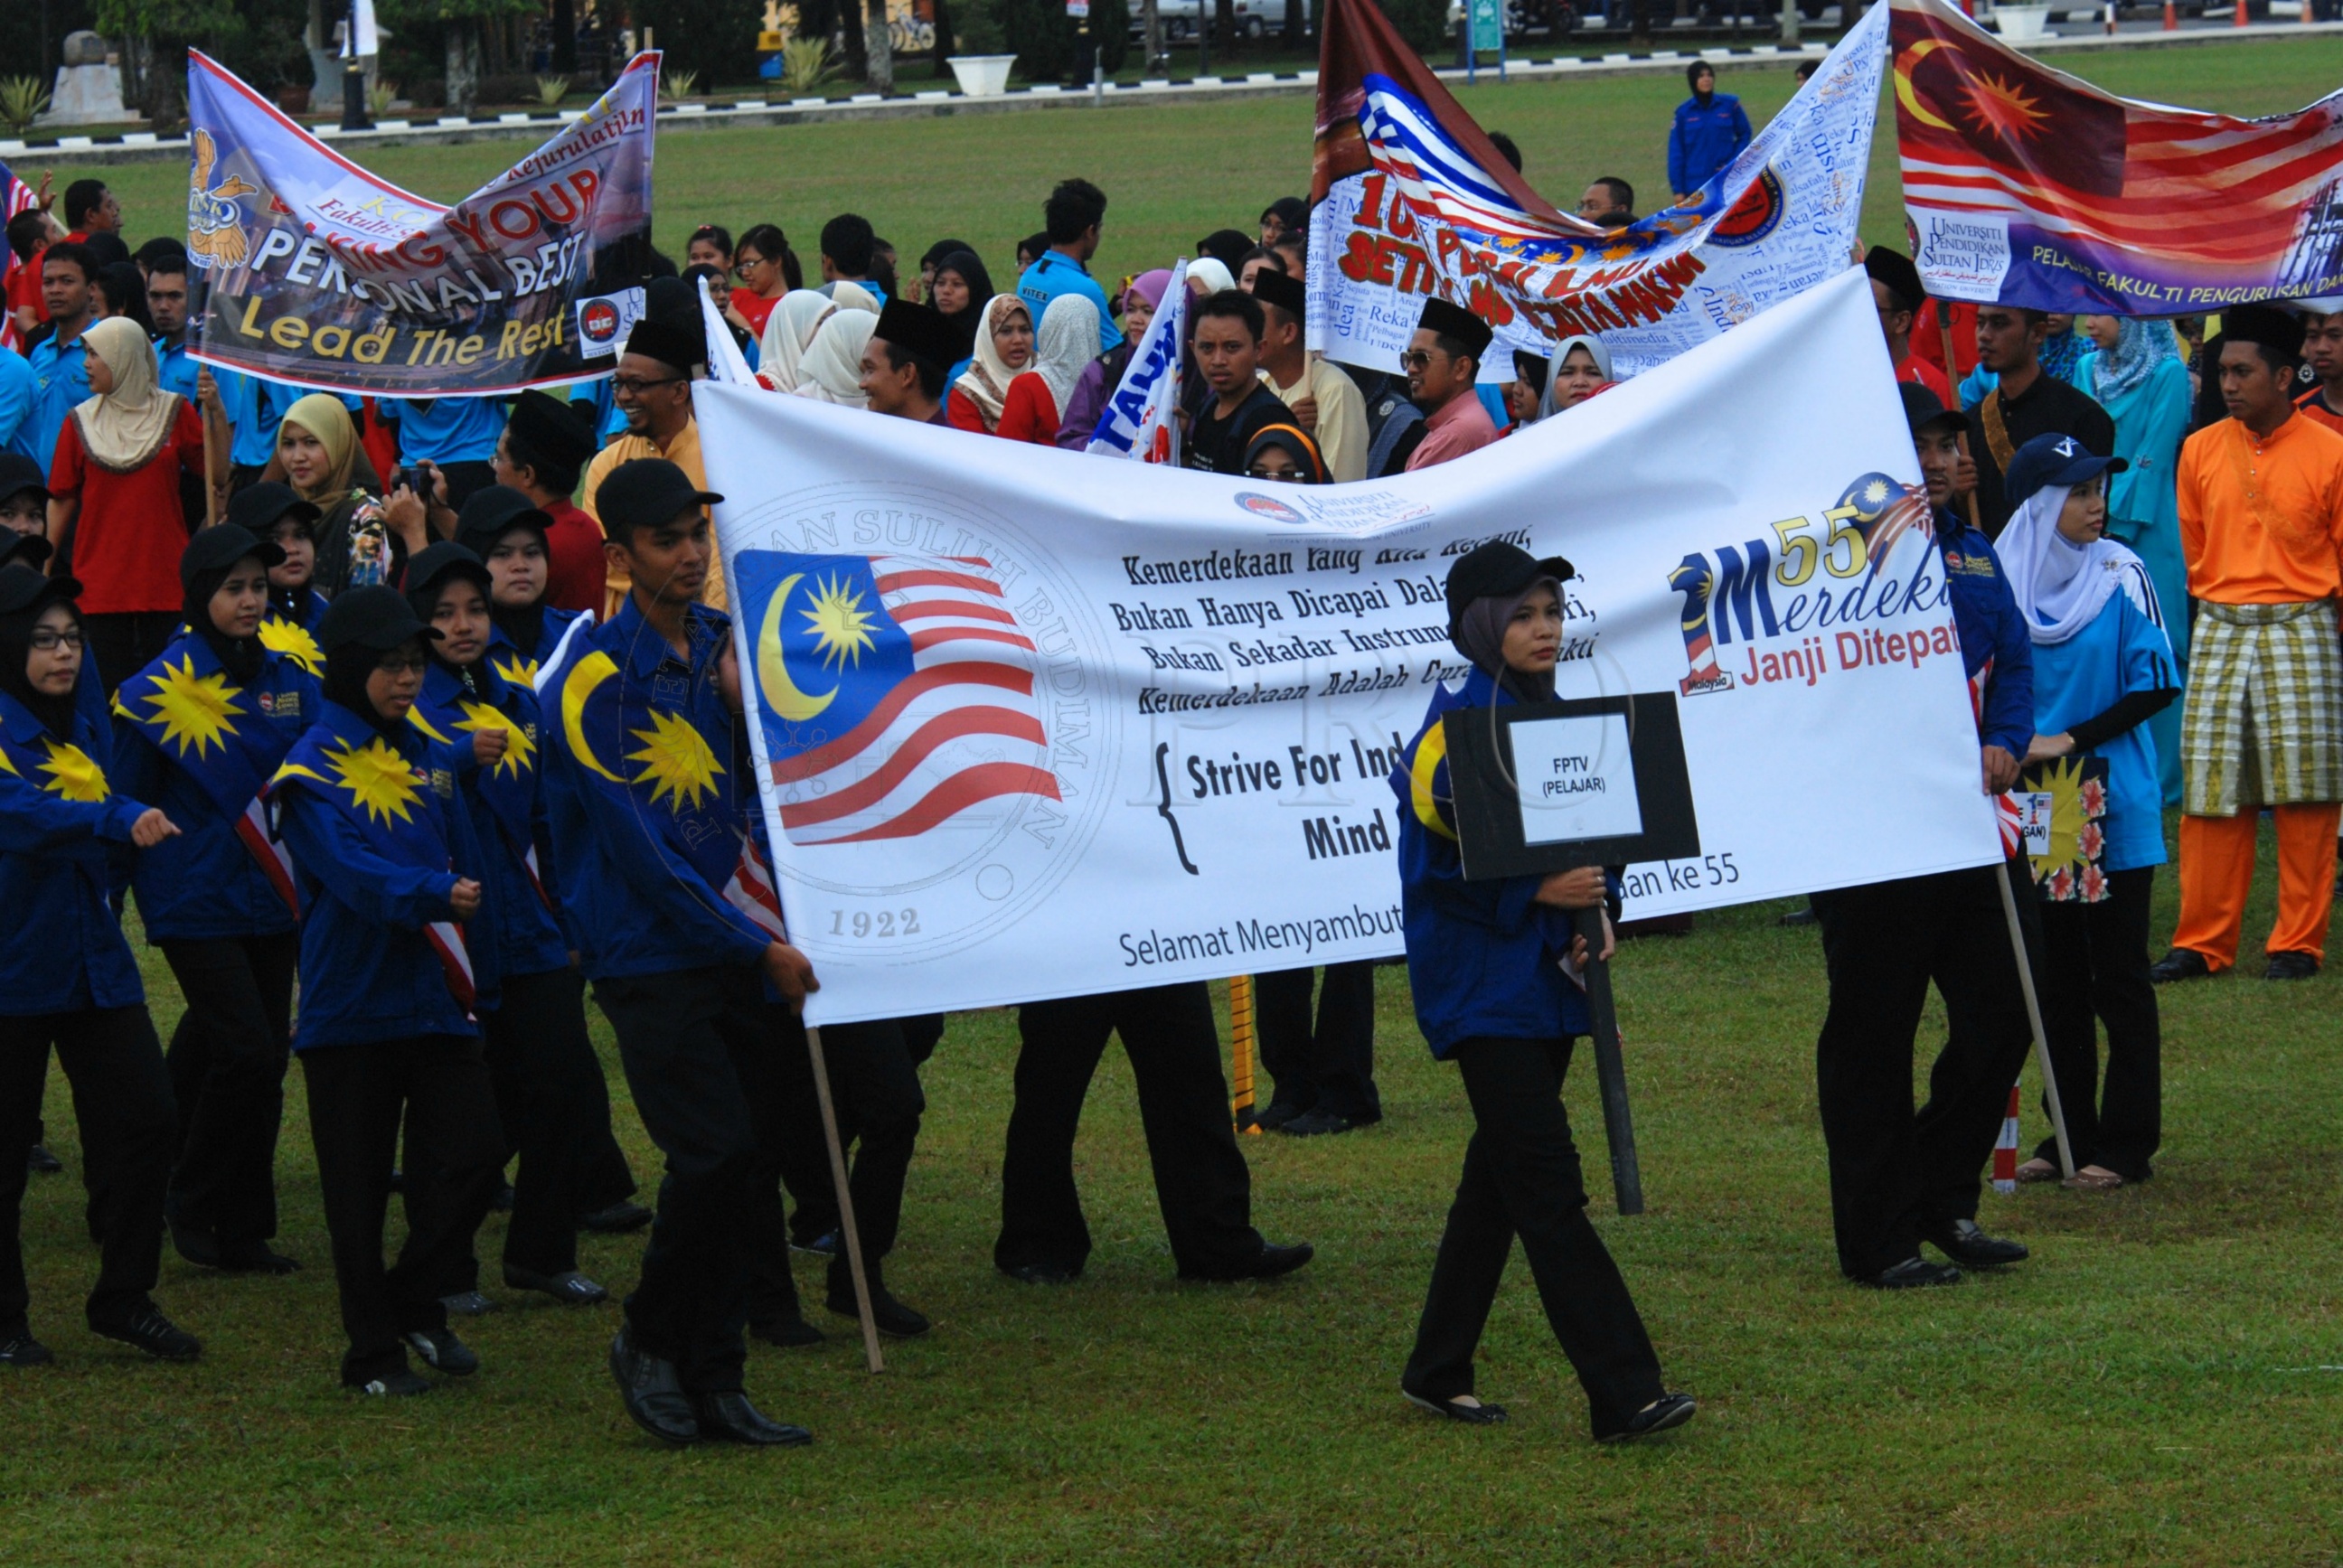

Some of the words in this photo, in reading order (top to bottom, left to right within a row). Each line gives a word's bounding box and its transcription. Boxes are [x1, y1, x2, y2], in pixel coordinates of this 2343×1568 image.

[1789, 174, 1826, 195] alsafah
[316, 197, 395, 237] Fakulti
[445, 169, 600, 252] YOUR
[1780, 211, 1810, 232] eka
[1931, 217, 2002, 240] UNIVERSITI
[502, 230, 585, 298] BEST
[1923, 246, 1971, 268] SULTAN
[1974, 253, 2005, 274] IDRIS
[1929, 232, 2005, 258] PENDIDIKAN
[2097, 271, 2184, 304] FAKULTI
[240, 294, 398, 365] Lead
[406, 329, 483, 367] The
[496, 303, 567, 361] Rest
[1369, 305, 1409, 329] Reka
[1123, 545, 1293, 586] Kemerdekaan
[1770, 504, 1869, 589] 55
[1110, 597, 1193, 633] Bukan
[1198, 591, 1284, 630] Hanya
[1290, 581, 1391, 624] Dicapai
[1393, 575, 1446, 606] Dala
[1142, 643, 1223, 673] Bukan
[1230, 633, 1338, 669] Sekadar
[1350, 622, 1450, 654] Instrum
[1741, 634, 1827, 687] Janji
[1834, 618, 1961, 671] Ditepat
[1137, 684, 1310, 715] Kemerdekaan
[1319, 669, 1409, 699] Adalah
[1555, 633, 1600, 662] kti
[1687, 674, 1727, 691] Malaysia
[1187, 750, 1283, 800] Strive
[1289, 739, 1343, 788] For
[1354, 731, 1405, 776] Ind
[1553, 756, 1589, 775] FPTV
[1542, 775, 1606, 798] (PELAJAR)
[1302, 808, 1392, 861] Mind
[1119, 928, 1234, 967] Selamat
[1236, 904, 1405, 955] Menyambut
[1618, 871, 1661, 901] aan
[1664, 859, 1702, 893] ke
[1704, 851, 1740, 887] 55
